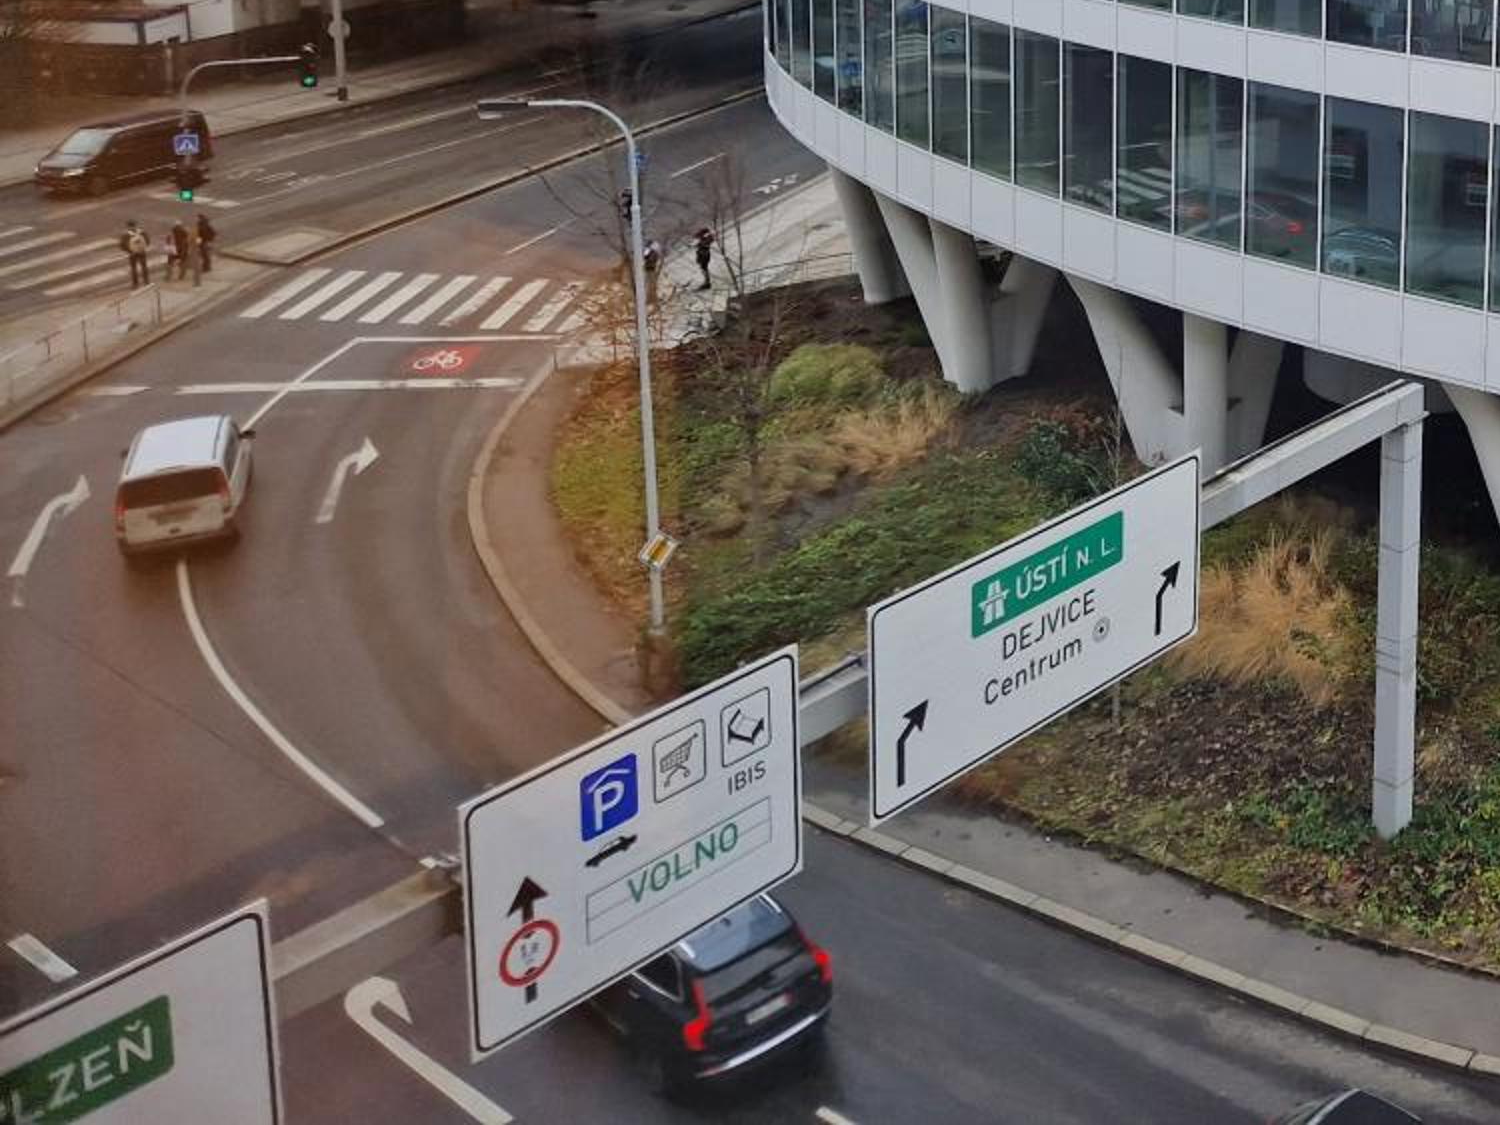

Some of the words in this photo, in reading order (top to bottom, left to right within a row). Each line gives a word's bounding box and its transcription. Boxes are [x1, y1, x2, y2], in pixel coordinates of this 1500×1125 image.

[1015, 544, 1069, 600] ÚSTÍ
[1002, 588, 1096, 661] DEJVICE
[984, 637, 1082, 706] Centrum
[726, 759, 767, 796] IBIS
[627, 822, 740, 904] VOLNO
[0, 1018, 154, 1125] LZEŇ
